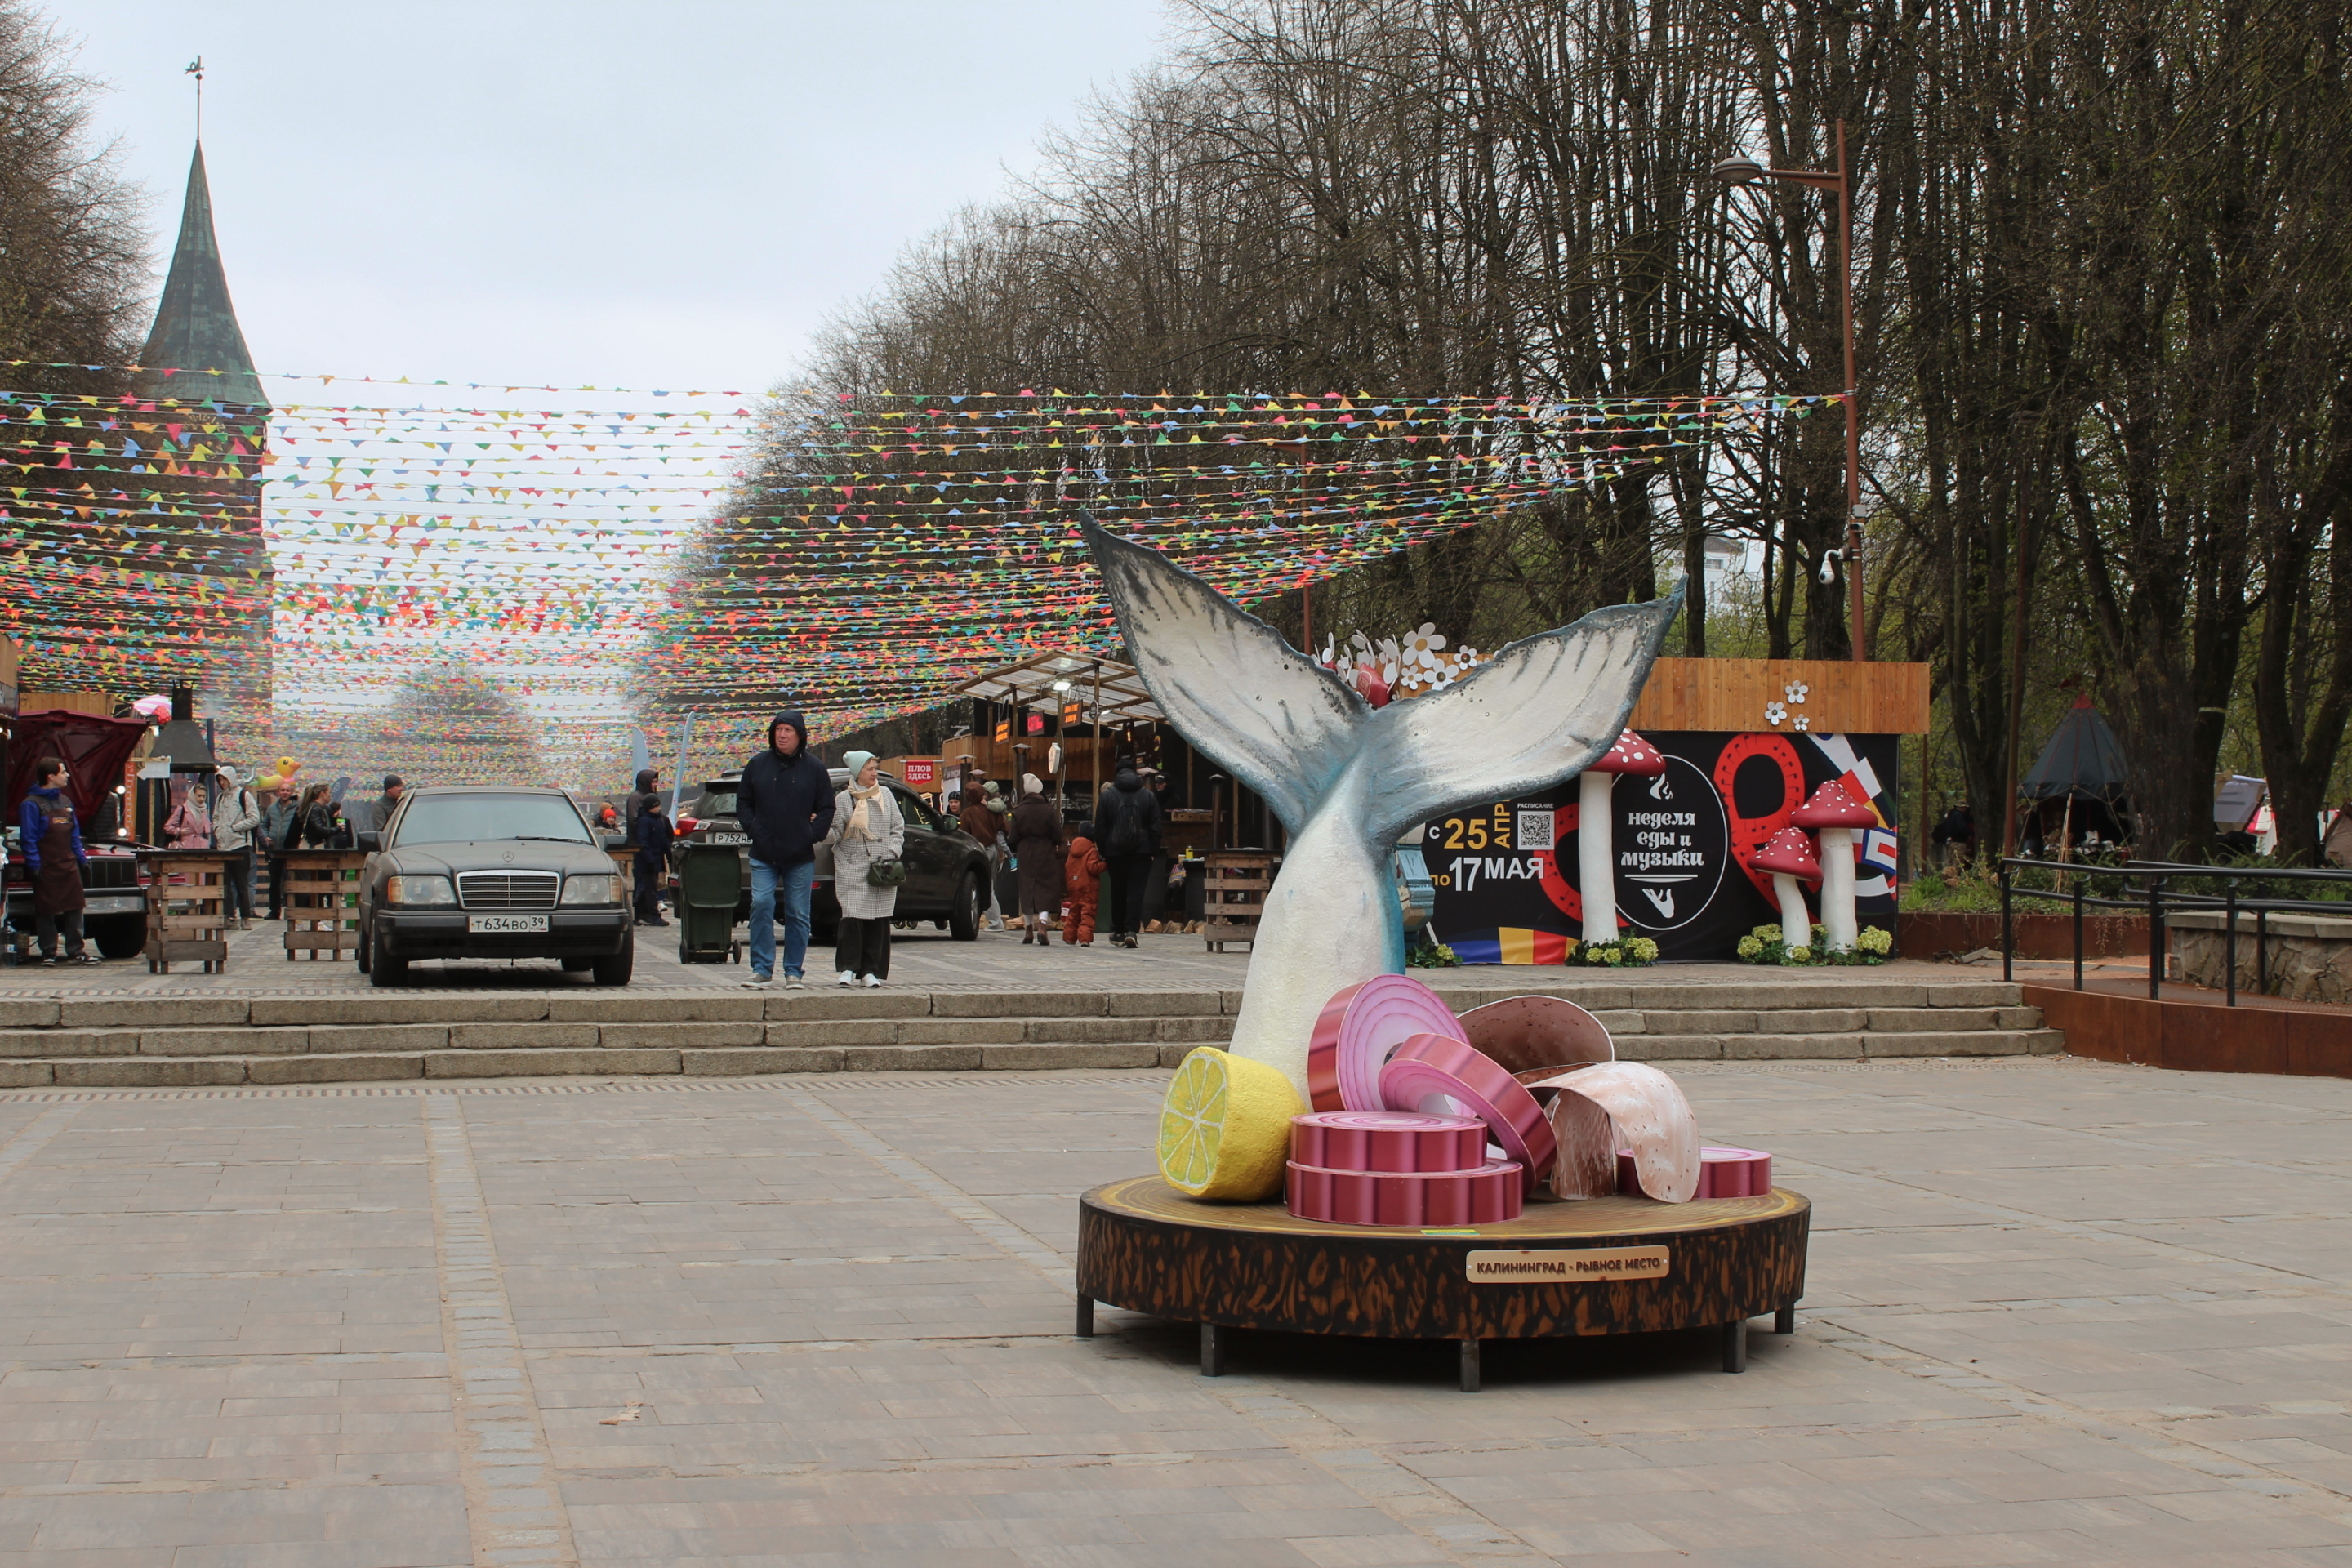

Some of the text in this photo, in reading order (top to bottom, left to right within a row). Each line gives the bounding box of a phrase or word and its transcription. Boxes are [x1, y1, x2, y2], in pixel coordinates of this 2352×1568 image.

[907, 773, 932, 782] ЗДЕСЬ
[1444, 818, 1488, 850] 25
[1494, 800, 1510, 849] АПР
[1628, 813, 1696, 830] неделя
[1637, 831, 1692, 850] еды и
[1620, 849, 1705, 871] музыки
[1449, 857, 1482, 892] 17
[1485, 858, 1544, 880] МАЯ
[531, 916, 544, 927] 39
[1477, 1262, 1566, 1275] КАЛИНИНГРАД
[1575, 1259, 1622, 1272] РЫБНОЕ
[1625, 1258, 1660, 1269] МЕСТО
